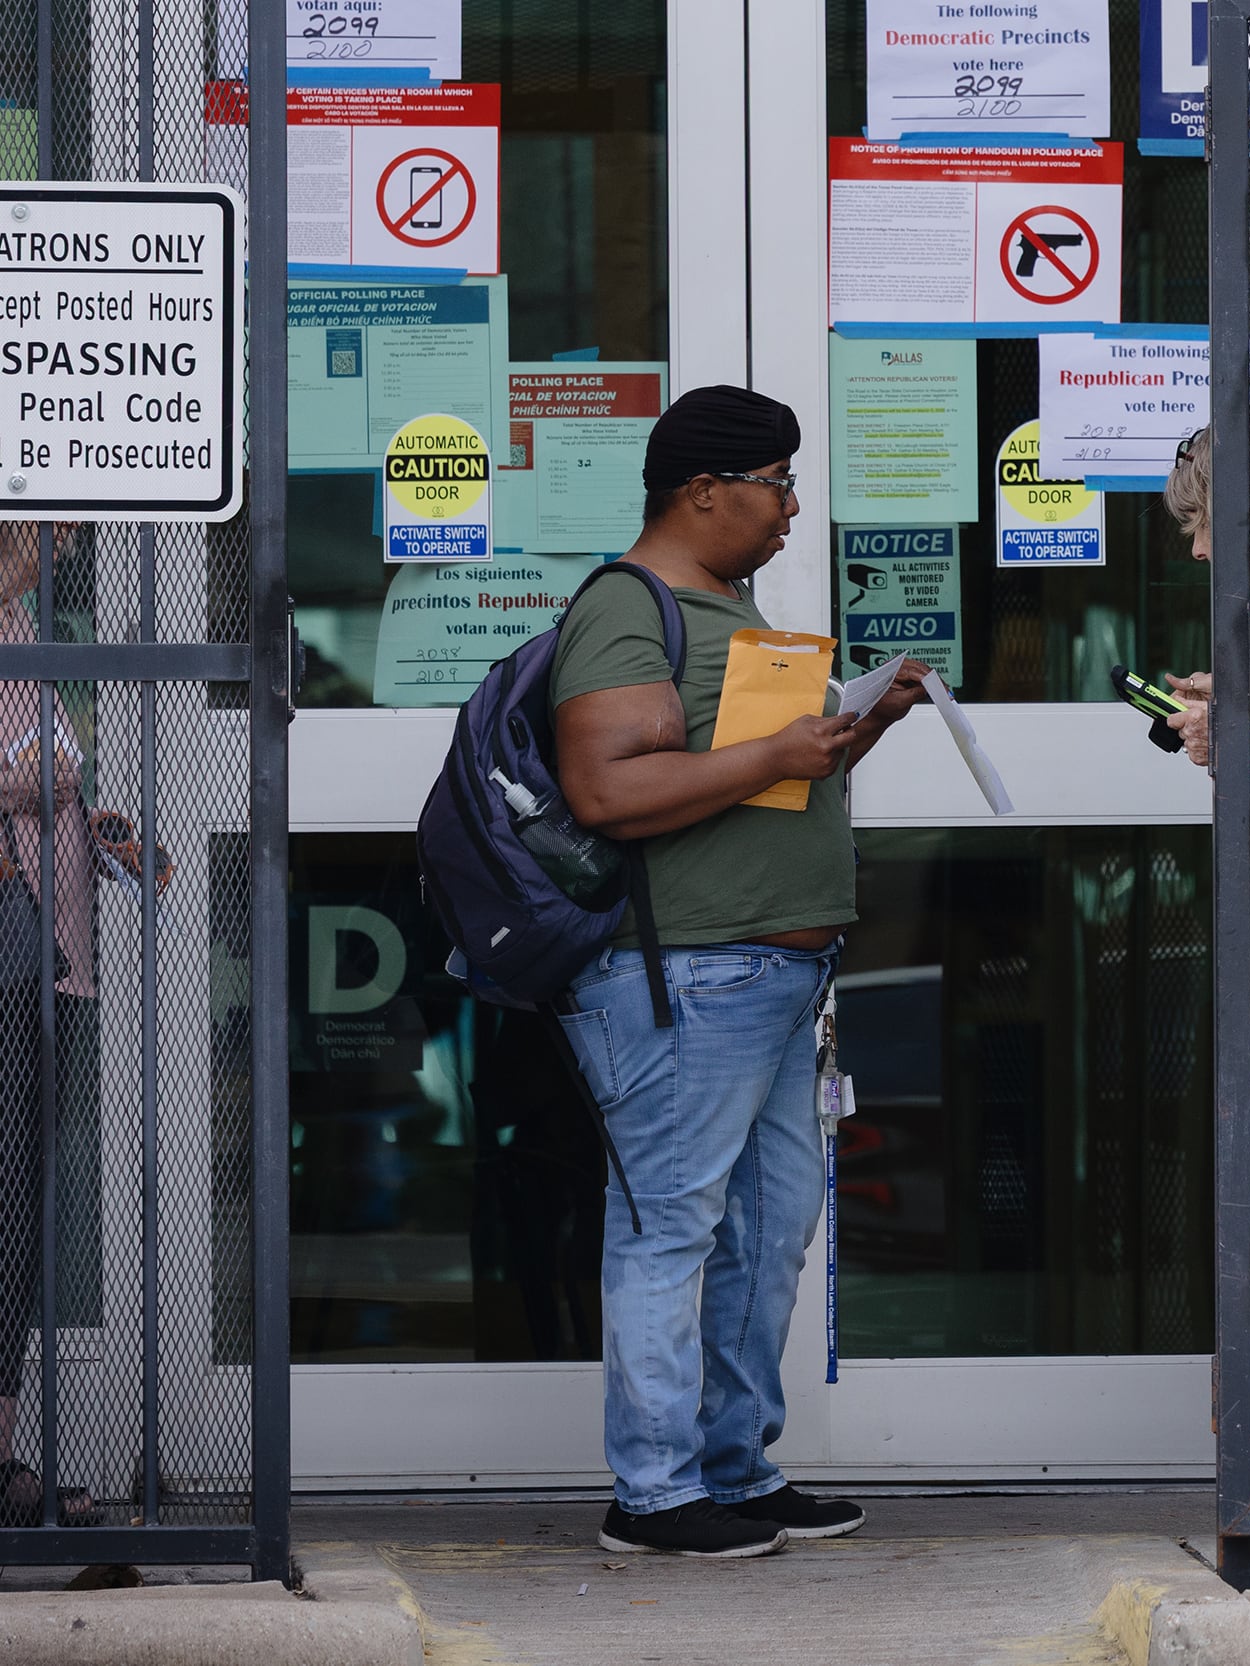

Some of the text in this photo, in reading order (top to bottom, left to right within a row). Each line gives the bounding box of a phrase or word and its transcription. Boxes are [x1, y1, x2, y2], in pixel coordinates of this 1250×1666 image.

[936, 4, 1039, 20] The following
[303, 14, 379, 38] 2099
[886, 28, 1090, 46] Democratic Precincts
[306, 40, 372, 59] 2100
[953, 58, 1024, 71] vote here
[954, 75, 1024, 97] 2099
[957, 98, 1023, 117] 2100
[850, 144, 885, 153] NOTICE
[886, 145, 899, 153] OF
[961, 147, 974, 155] OF
[975, 147, 1020, 156] HANDGUN
[1022, 148, 1031, 156] IN
[1033, 148, 1072, 157] POLLING
[1073, 148, 1103, 157] PLACE
[132, 234, 205, 264] ONLY
[290, 288, 425, 300] OFFICIAL POLLING PLACE
[57, 290, 133, 321] Posted
[150, 293, 213, 323] Hours
[1110, 345, 1211, 361] The following
[512, 377, 603, 387] POLLING PLACE
[1060, 370, 1165, 388] Republican
[20, 391, 202, 423] Penal Code
[1124, 400, 1195, 412] vote here
[395, 435, 479, 450] AUTOMATIC
[20, 438, 212, 469] Be Prosecuted
[389, 458, 485, 478] CAUTION
[416, 486, 460, 500] DOOR
[1029, 491, 1072, 505] DOOR
[392, 526, 485, 541] ACTIVATE SWITCH
[1005, 531, 1098, 545] ACTIVATE SWITCH
[406, 541, 471, 555] TO OPERATE
[852, 533, 945, 554] NOTICE
[1019, 546, 1084, 559] TO OPERATE
[436, 567, 543, 583] Los siguientes
[893, 562, 951, 573] ALL ACTIVITIES
[899, 574, 945, 585] MONITORED
[904, 586, 940, 597] BY VIDEO
[392, 594, 471, 614] precintos
[906, 597, 939, 608] CAMERA
[446, 622, 532, 638] votan aquí:
[864, 617, 937, 637] AVISO
[309, 906, 407, 1014] D
[325, 1020, 387, 1032] Democrat
